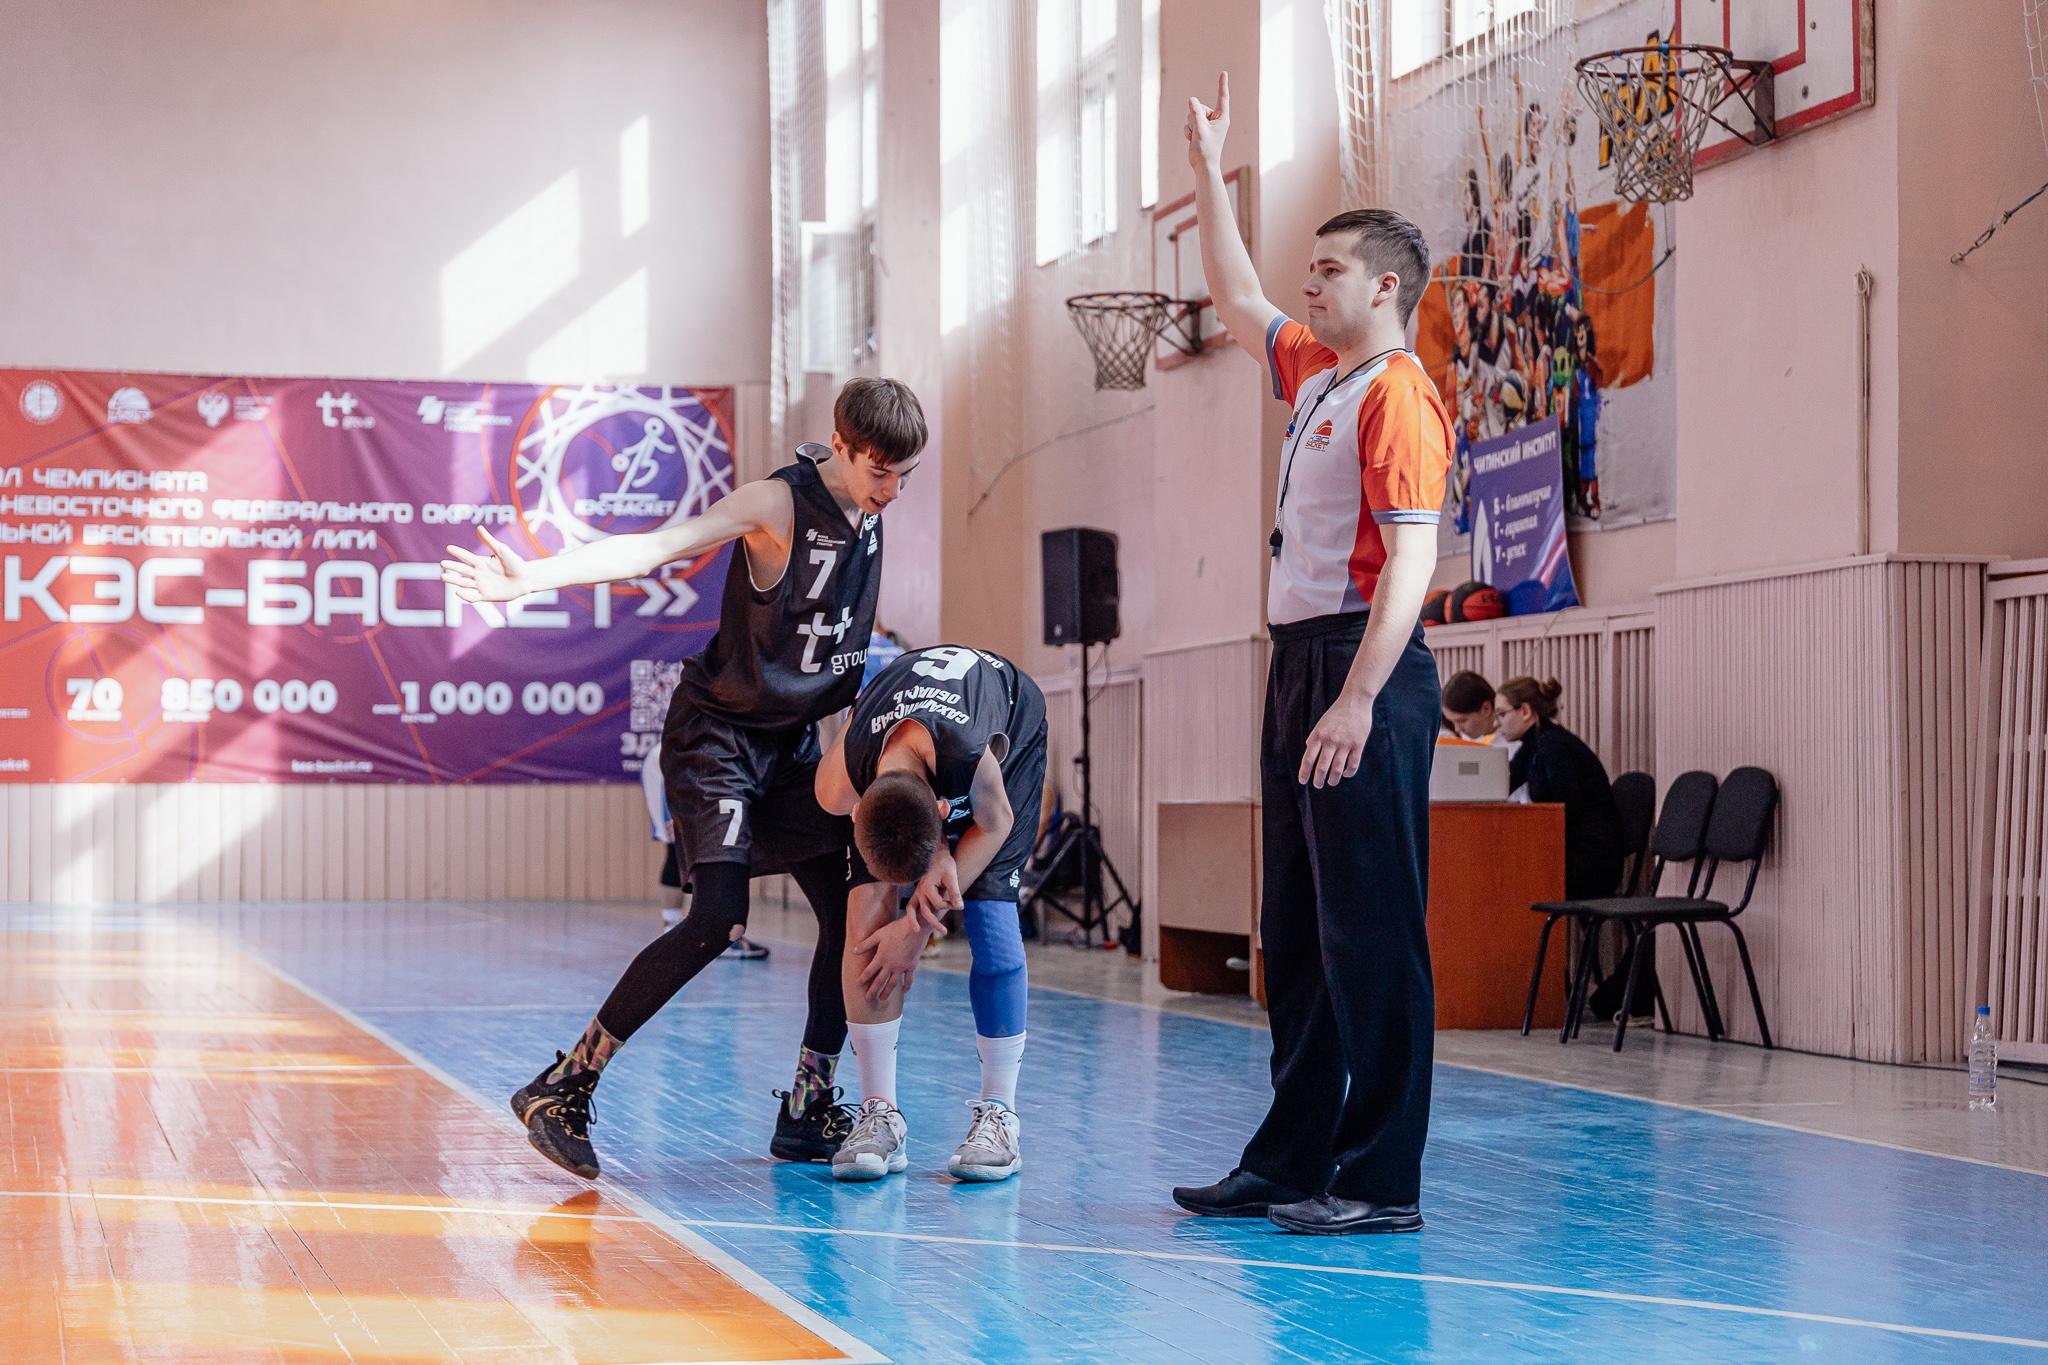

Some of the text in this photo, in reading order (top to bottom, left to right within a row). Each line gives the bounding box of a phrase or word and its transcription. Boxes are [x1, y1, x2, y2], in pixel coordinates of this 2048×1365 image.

[1473, 440, 1521, 476] ЧИТИНСКИЙ
[1521, 430, 1557, 460] ИНСТИТУТ
[0, 466, 208, 492] Л ЧЕМПИОНАТА
[0, 494, 517, 525] НЕВОСТОЧНОГО ФЕДЕРАЛЬНОГО ОКРУГА
[0, 519, 377, 550] ЬНОЙ БАСКЕТБОЛЬНОЙ ЛИГИ
[806, 549, 837, 599] 7
[831, 647, 870, 675] grou
[911, 646, 980, 681] 6
[66, 678, 124, 711] 70
[161, 678, 338, 714] 850 000
[400, 681, 605, 715] 1 000 000
[718, 799, 743, 846] 7
